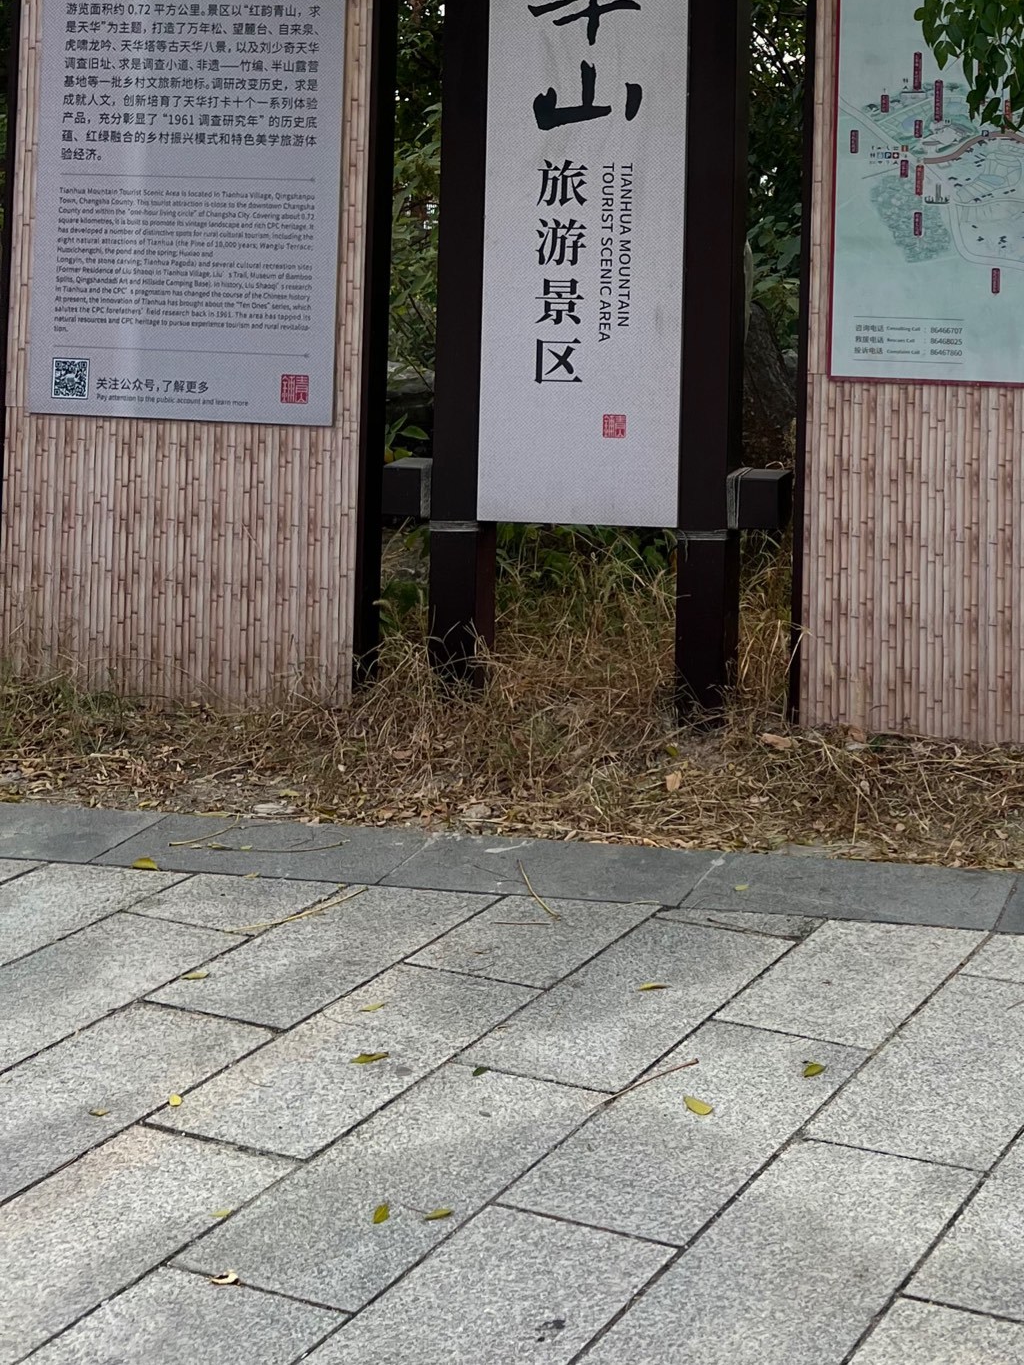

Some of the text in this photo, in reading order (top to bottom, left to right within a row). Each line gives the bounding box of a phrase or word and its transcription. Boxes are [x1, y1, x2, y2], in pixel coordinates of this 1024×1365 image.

[534, 159, 588, 384] 旅游景区
[598, 162, 615, 343] TOURIST SCENIC AREA
[617, 163, 633, 327] TIANHUA MOUNTAIN
